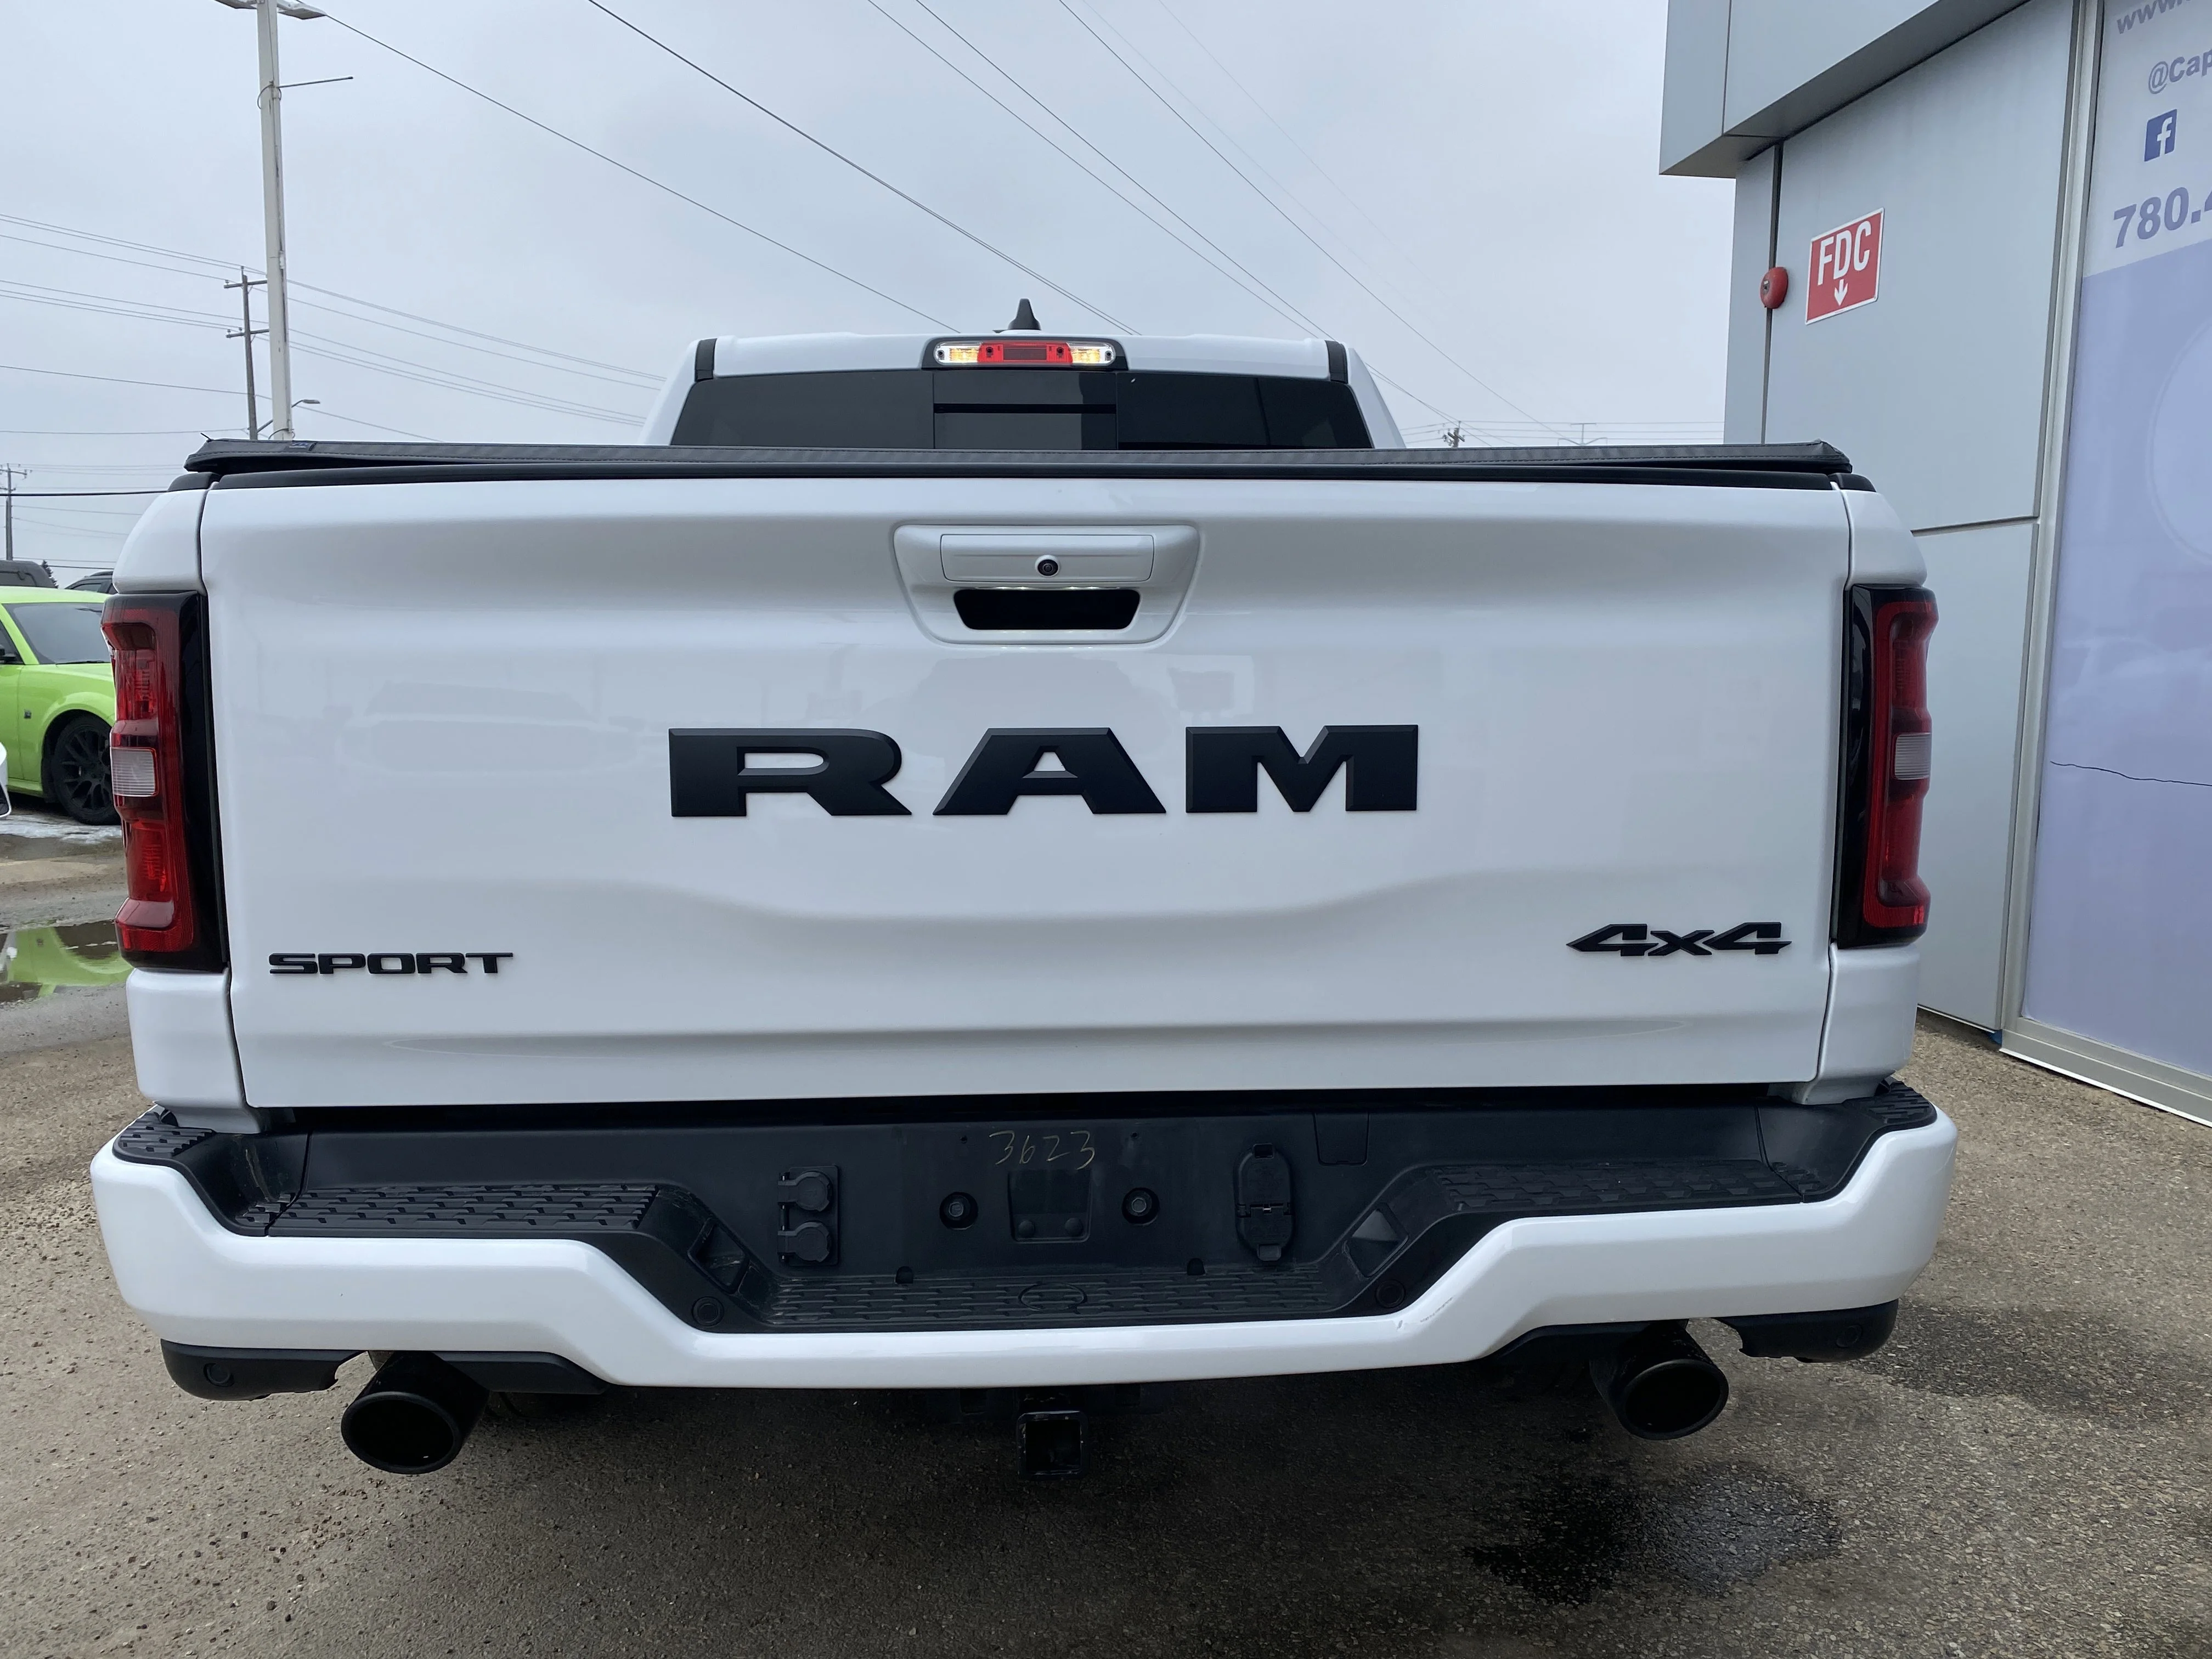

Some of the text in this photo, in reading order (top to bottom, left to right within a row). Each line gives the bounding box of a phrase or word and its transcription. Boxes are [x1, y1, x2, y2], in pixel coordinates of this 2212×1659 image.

[2117, 0, 2191, 34] www.
[2148, 48, 2212, 94] @Cap
[2113, 187, 2212, 249] 780.
[1818, 221, 1871, 285] FDC
[669, 725, 1419, 817] RAM
[1566, 922, 1792, 956] 4x4
[268, 952, 514, 974] SPORT
[989, 1130, 1095, 1170] 3623
